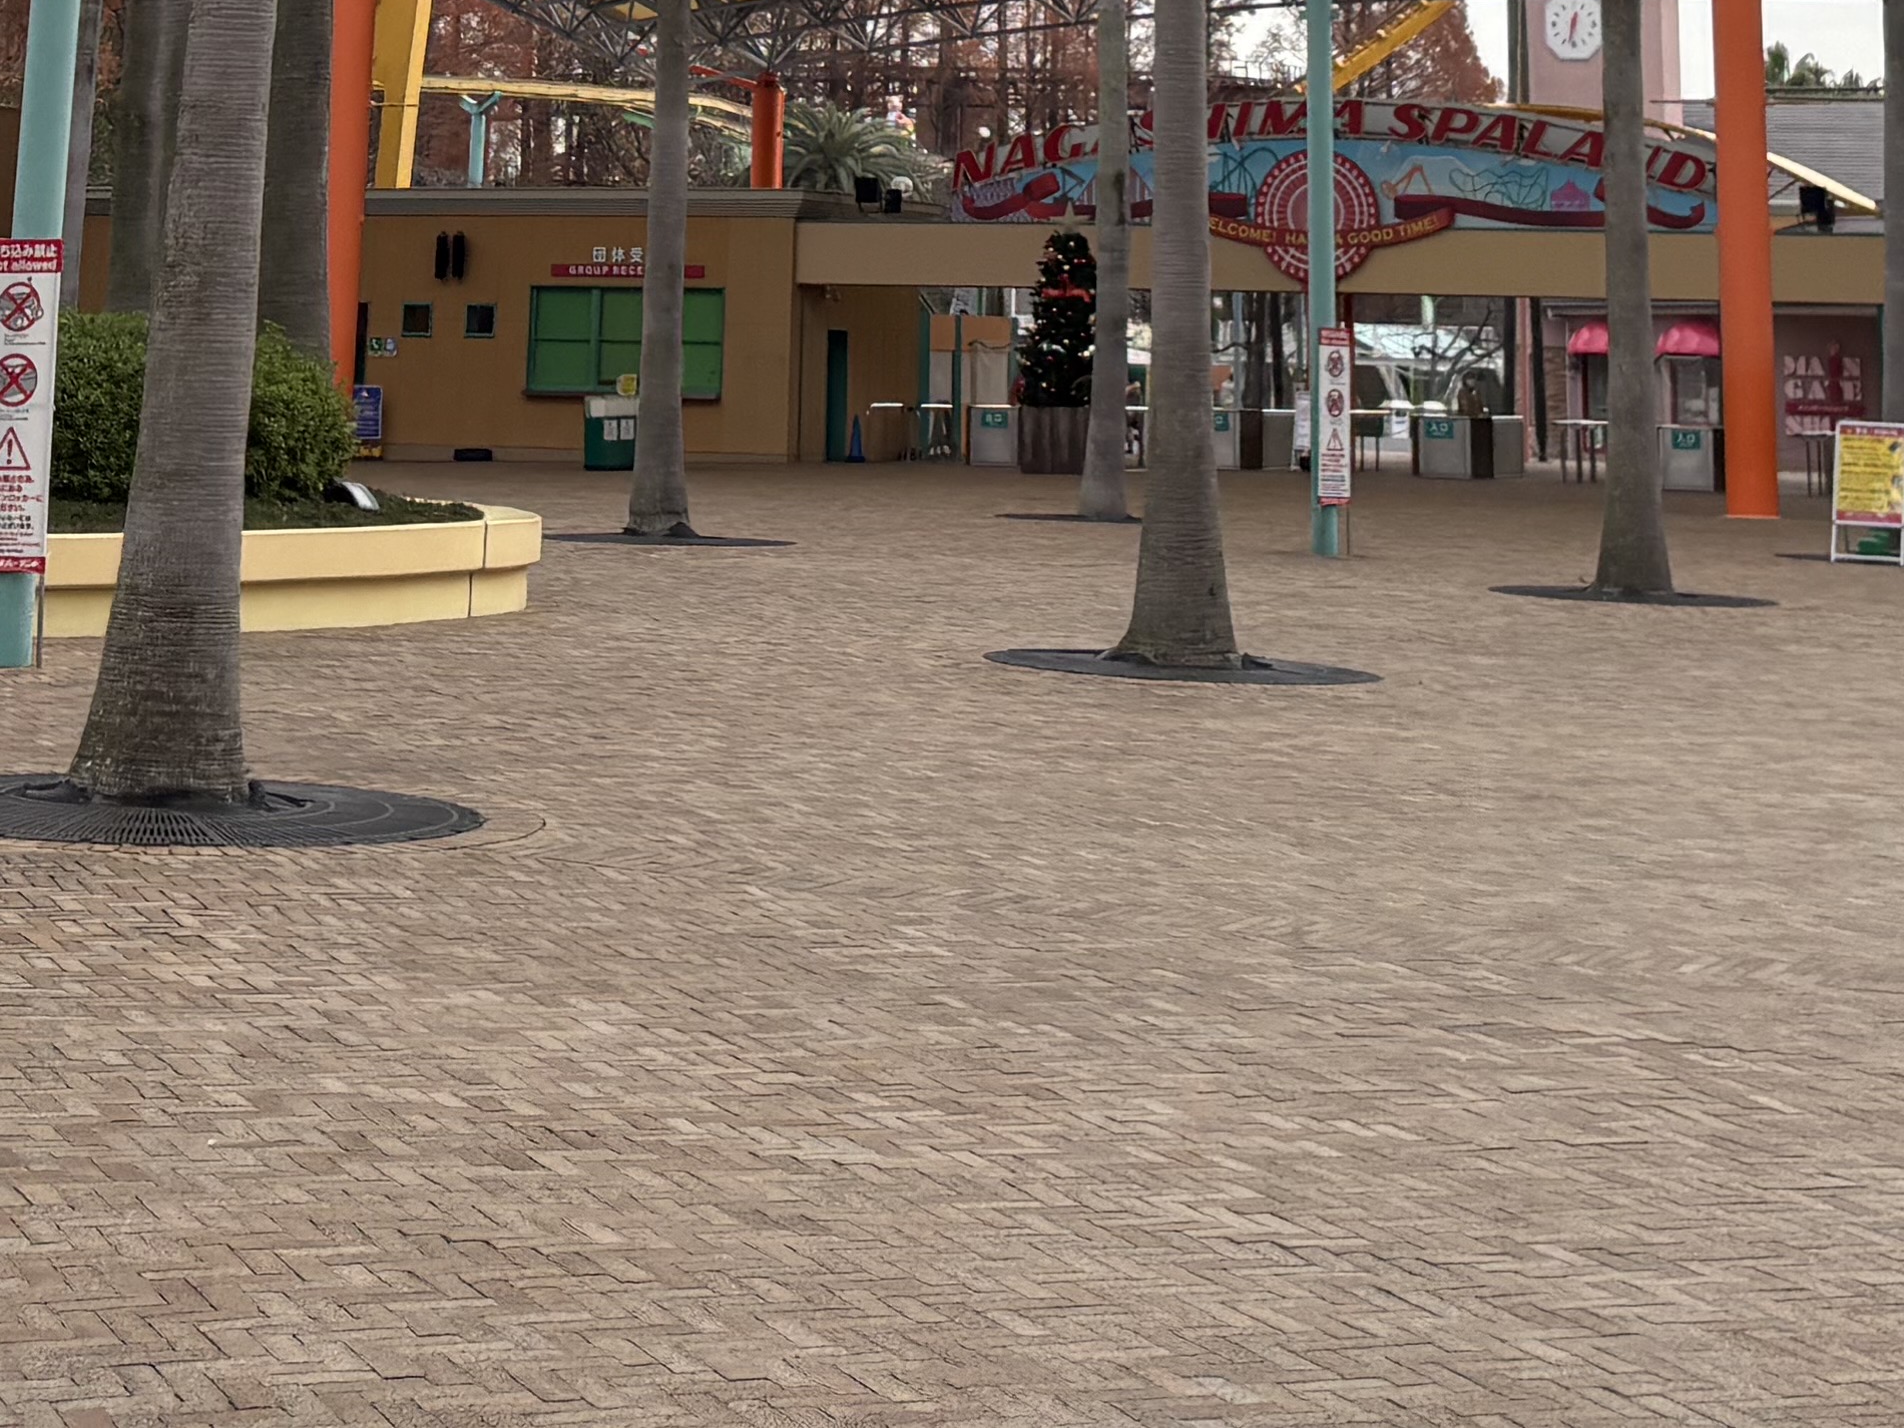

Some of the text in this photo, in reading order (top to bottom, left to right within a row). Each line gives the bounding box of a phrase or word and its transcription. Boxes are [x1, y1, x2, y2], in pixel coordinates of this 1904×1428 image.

[952, 98, 1709, 191] NAGIMA SPALAD
[1208, 216, 1277, 243] ELCOME!
[1347, 227, 1394, 245] GOOD
[1398, 215, 1439, 239] TIME!
[592, 246, 645, 263] 団体受
[10, 259, 57, 273] allowed
[568, 265, 609, 276] GROUP
